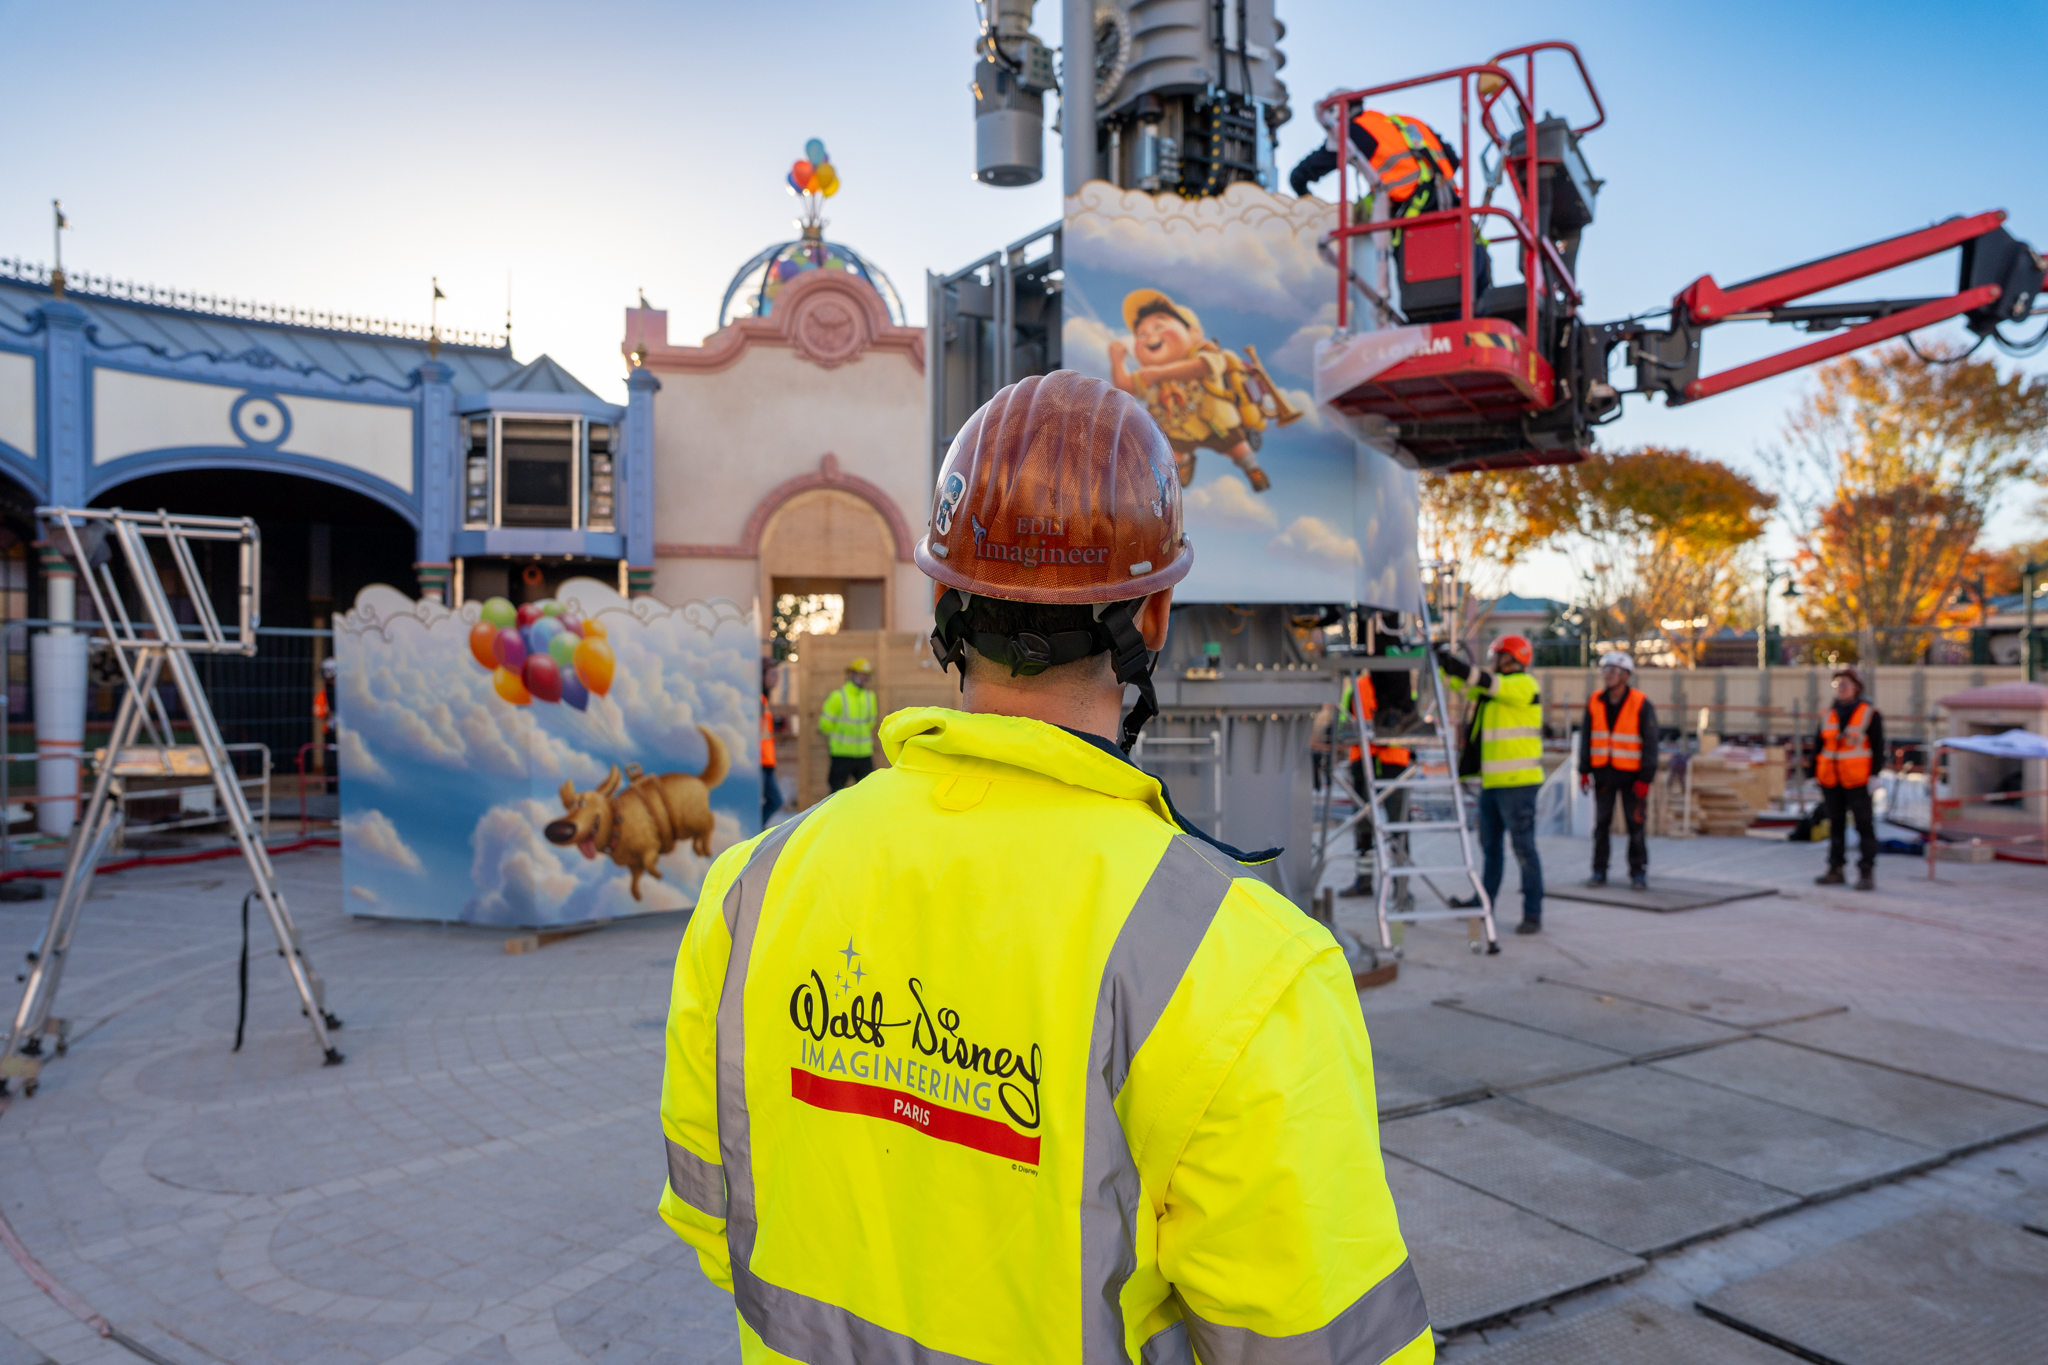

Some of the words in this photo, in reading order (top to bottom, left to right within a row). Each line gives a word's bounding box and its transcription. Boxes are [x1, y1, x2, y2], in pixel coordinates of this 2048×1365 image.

[975, 533, 1108, 568] Imagineer
[790, 968, 911, 1048] Walt
[908, 977, 1042, 1129] Disney
[801, 1038, 991, 1111] IMAGINEERING
[893, 1098, 930, 1126] PARIS
[1018, 1165, 1038, 1177] Disney
